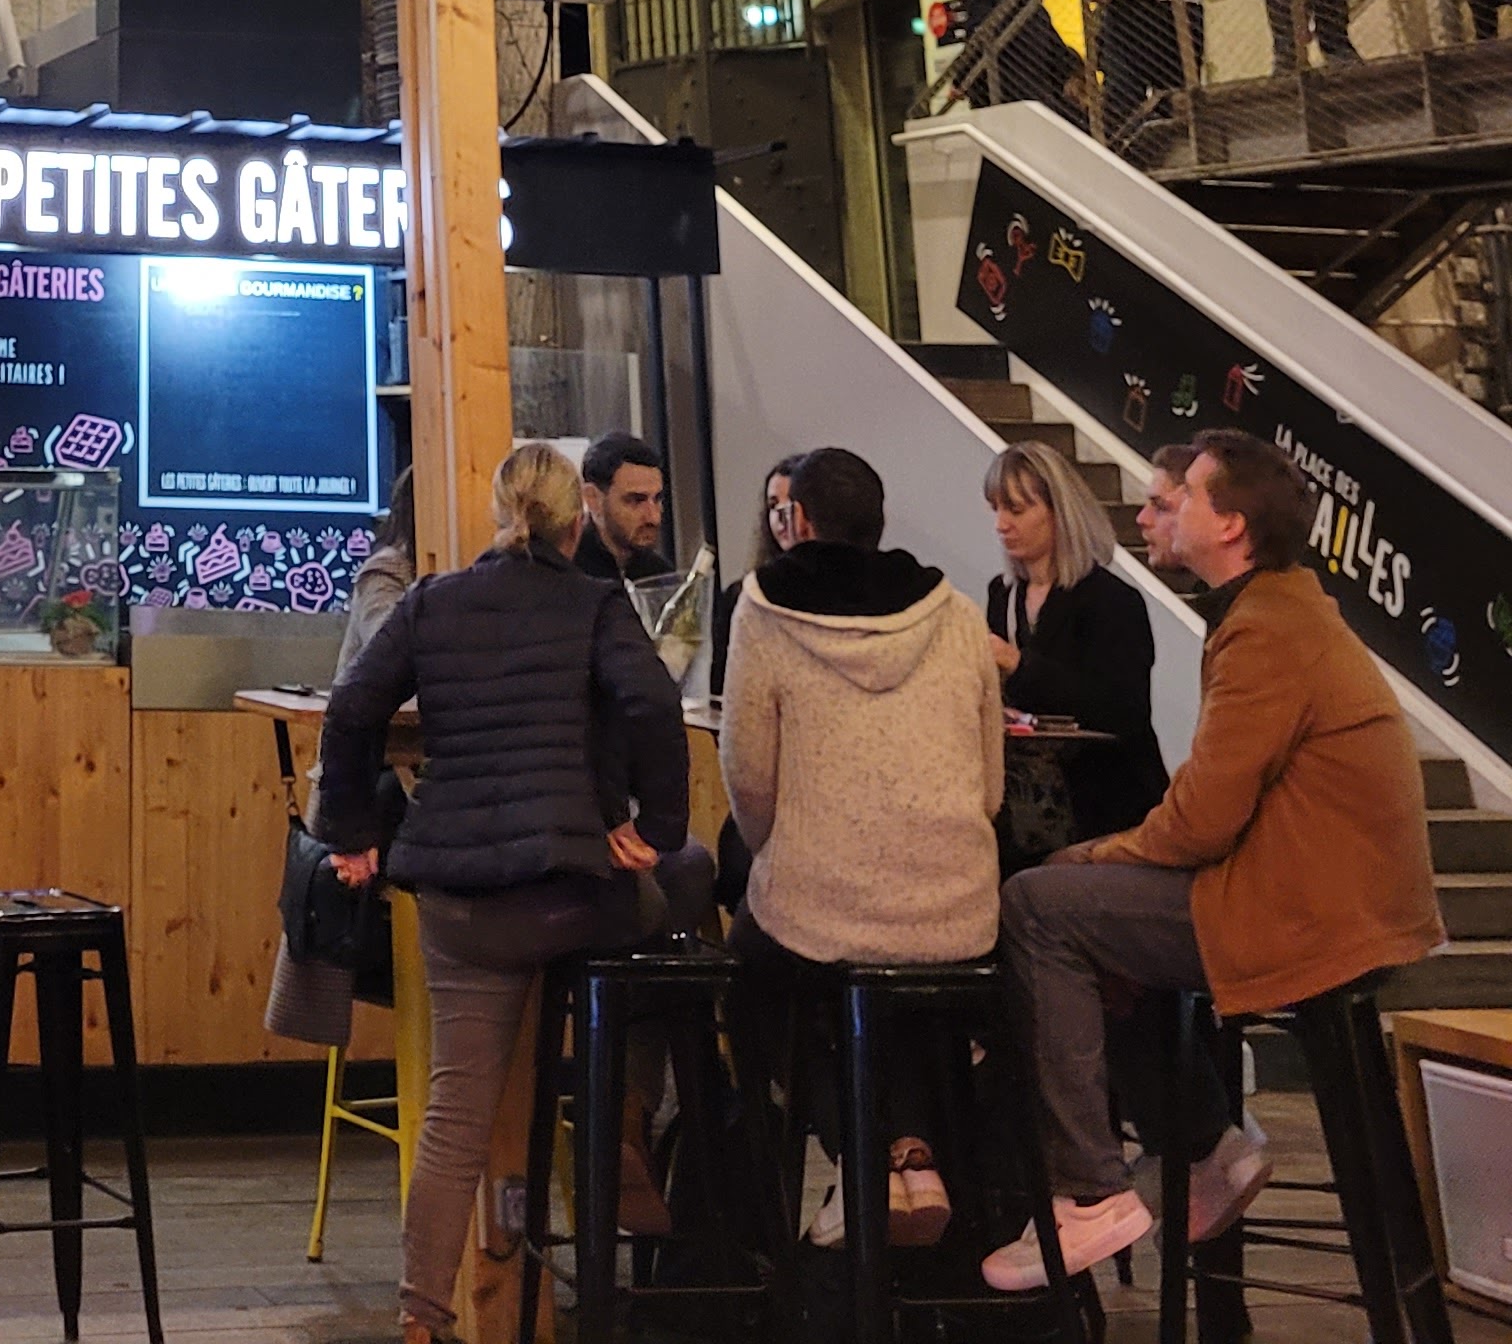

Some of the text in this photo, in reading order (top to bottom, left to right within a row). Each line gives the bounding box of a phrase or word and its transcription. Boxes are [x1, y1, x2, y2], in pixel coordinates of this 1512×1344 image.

[238, 149, 514, 251] GÂTER
[239, 279, 352, 301] GOURMANDISE
[352, 284, 364, 302] ?
[58, 364, 66, 386] !
[1274, 424, 1361, 506] LA PLACE DES
